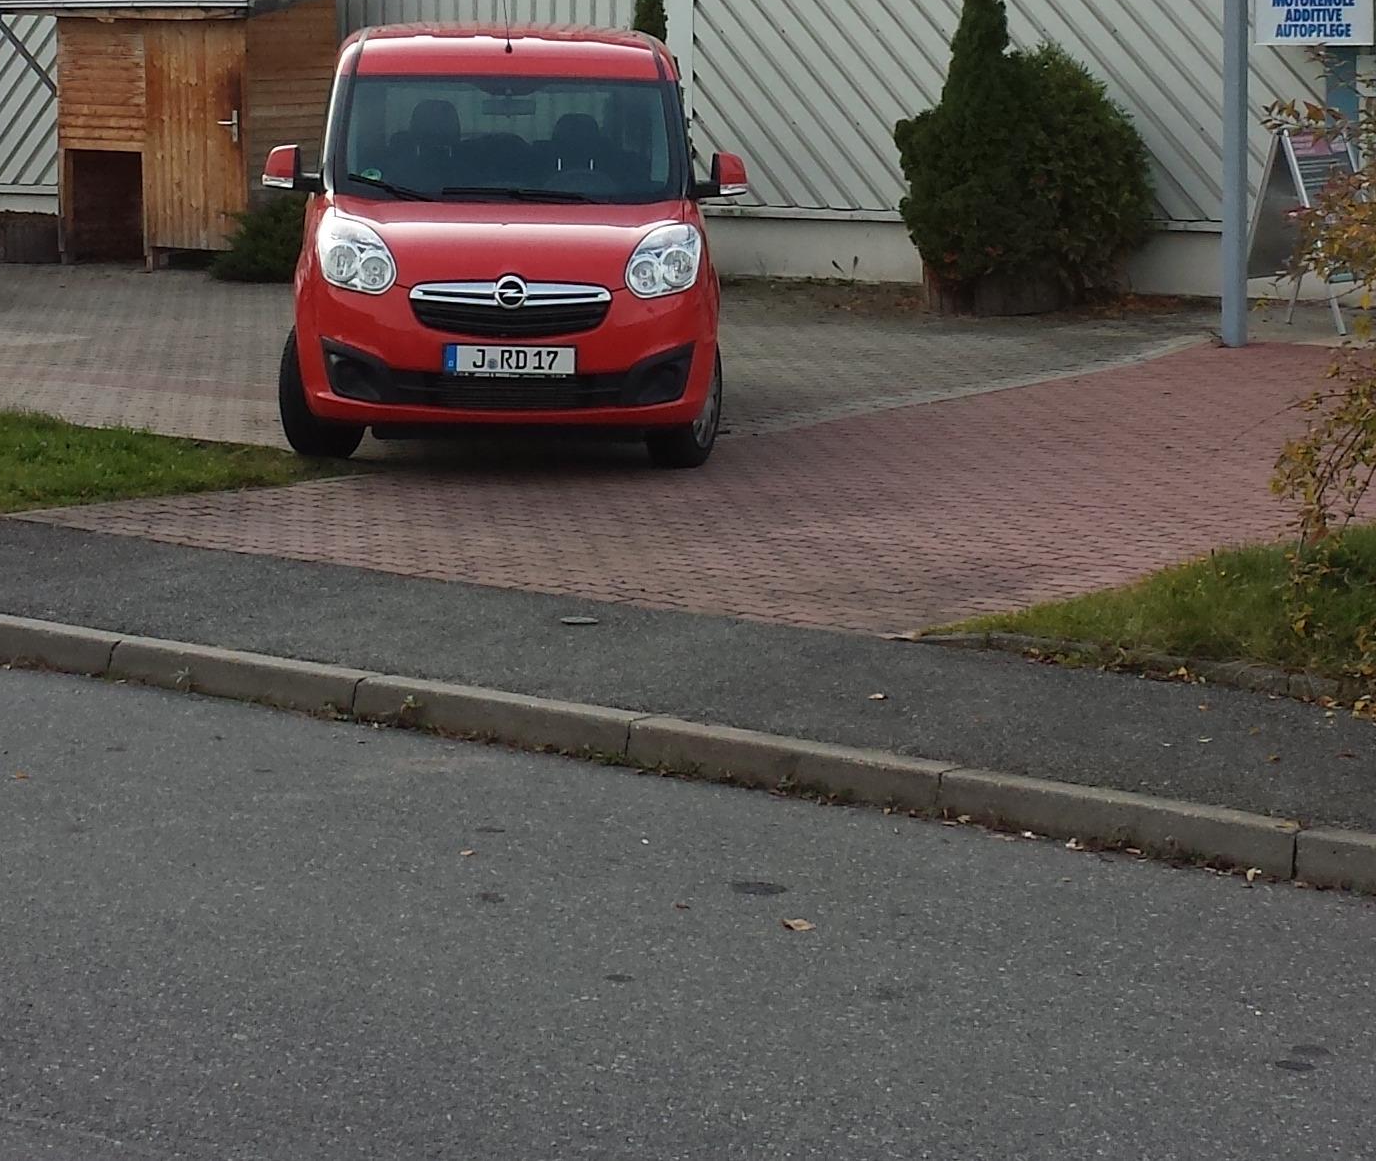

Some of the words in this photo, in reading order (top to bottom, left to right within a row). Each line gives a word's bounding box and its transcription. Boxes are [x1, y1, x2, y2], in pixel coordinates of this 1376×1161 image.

[1285, 8, 1342, 22] ADDITIVE
[1275, 23, 1351, 37] AUTOPFLEGE
[472, 349, 486, 368] J
[500, 349, 528, 370] RD
[532, 350, 559, 370] 17
